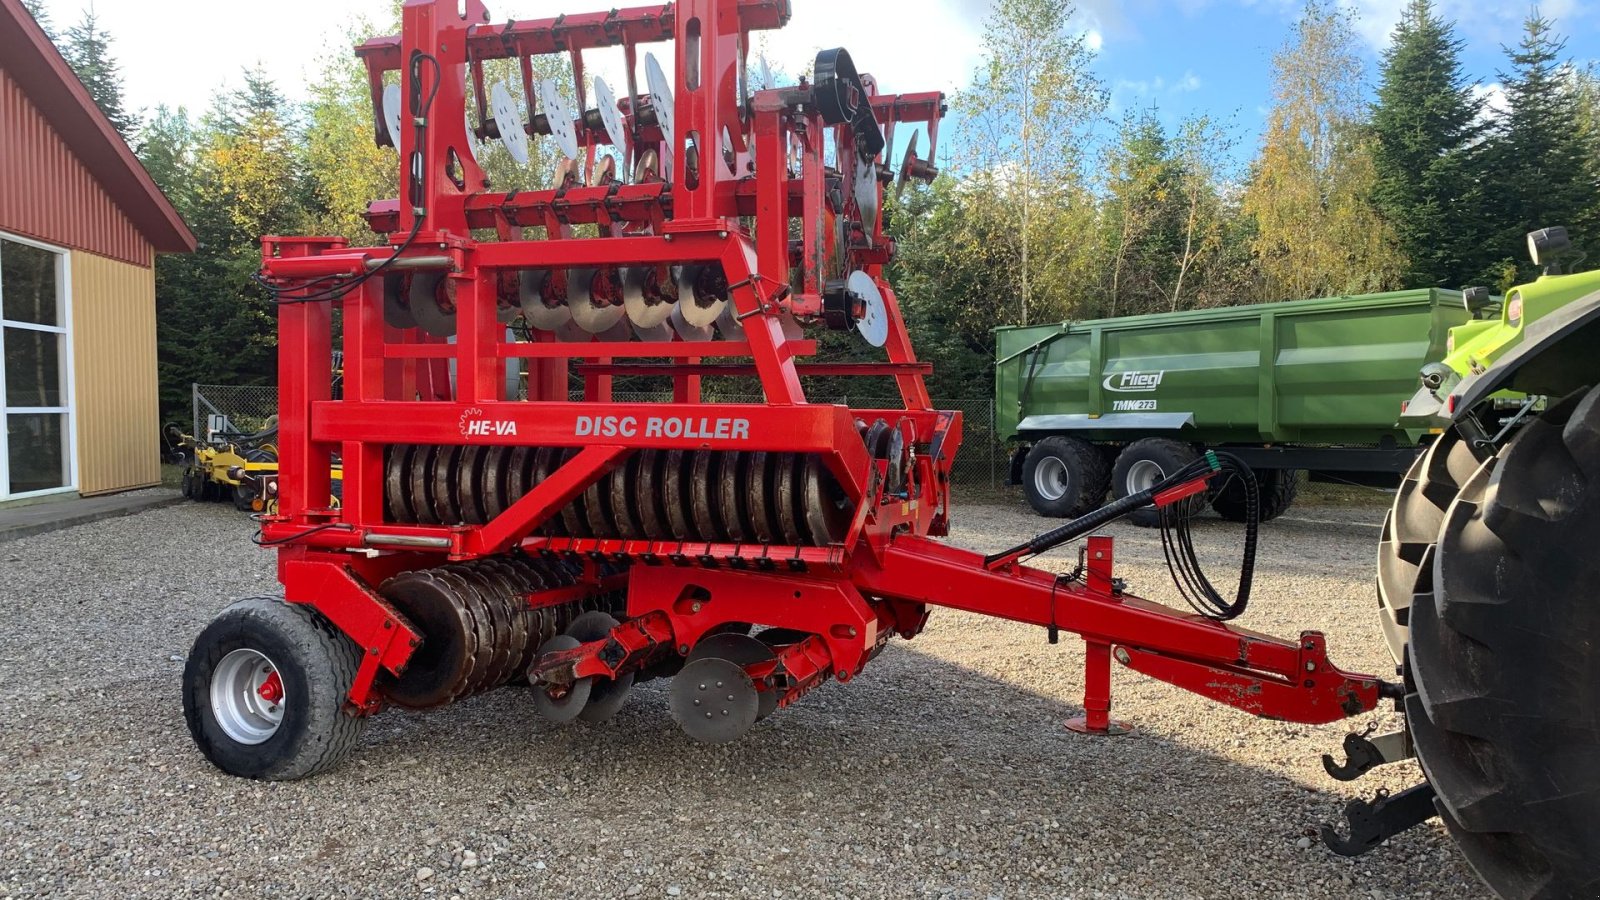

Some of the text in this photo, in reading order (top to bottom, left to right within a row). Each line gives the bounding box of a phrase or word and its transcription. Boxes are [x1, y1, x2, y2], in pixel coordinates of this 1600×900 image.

[1120, 370, 1164, 389] Fliegl
[468, 420, 517, 436] HE-VA
[575, 416, 750, 440] DISC ROLLER
